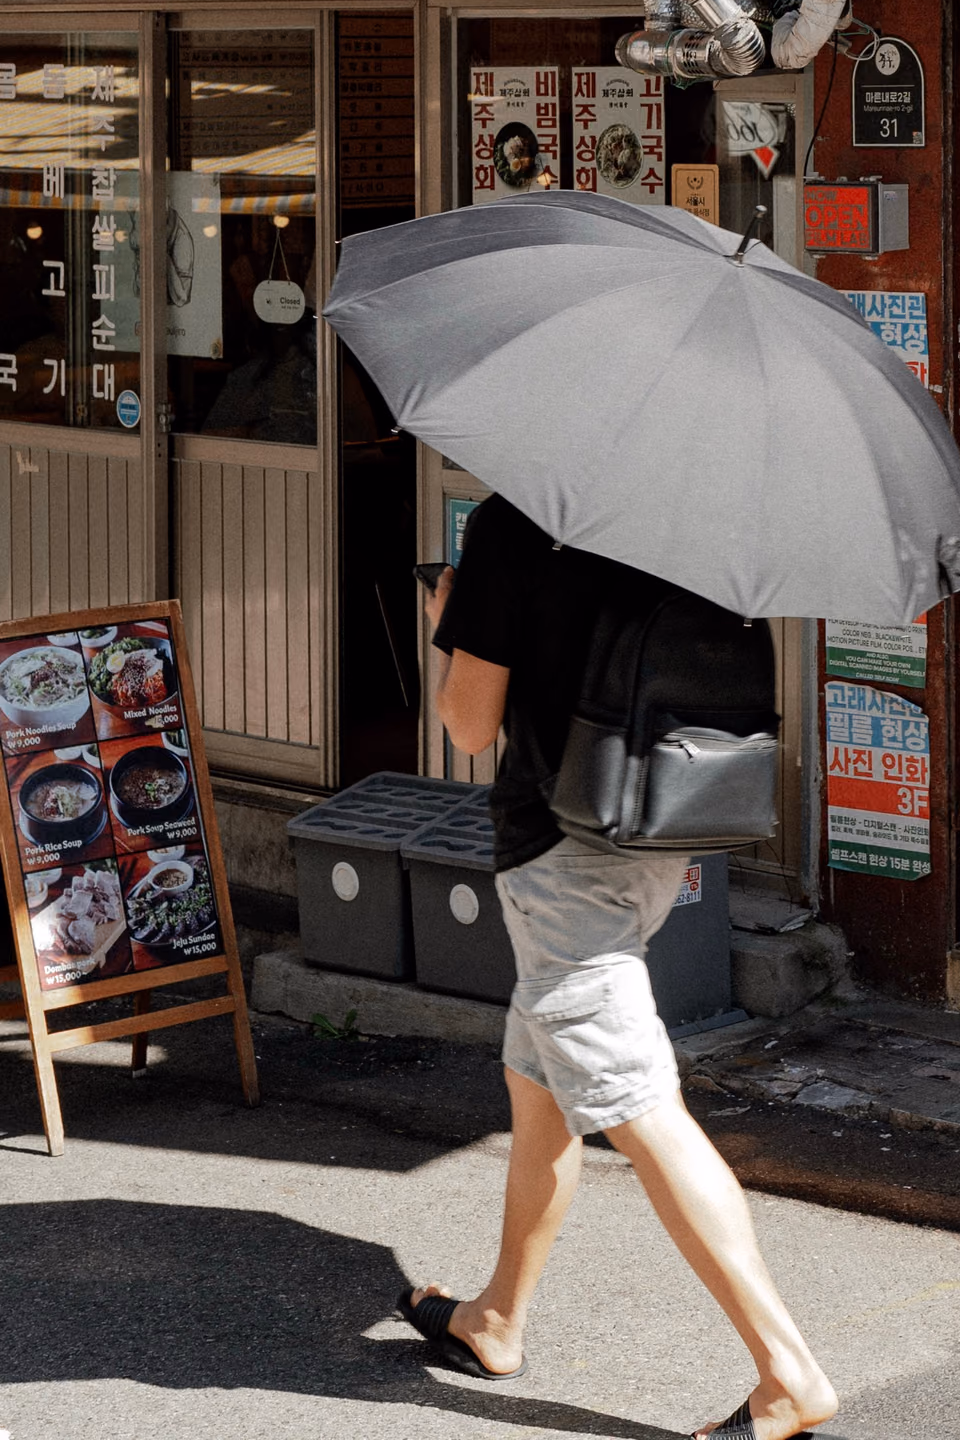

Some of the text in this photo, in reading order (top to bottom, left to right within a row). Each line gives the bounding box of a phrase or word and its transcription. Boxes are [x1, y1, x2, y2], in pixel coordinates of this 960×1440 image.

[865, 91, 911, 104] 마른내로2길
[473, 71, 496, 191] 제주상회
[535, 70, 559, 189] 비빔국수
[574, 71, 598, 193] 제주상회
[880, 118, 898, 138] 31
[806, 190, 838, 202] NOW
[805, 206, 868, 228] OPEN
[42, 63, 66, 397] 돔베고기
[806, 231, 868, 247] FILM LAB
[280, 296, 300, 305] Closed
[828, 684, 926, 718] 고래사진
[124, 705, 177, 719] Mixed Noodles
[6, 723, 77, 740] Pork Noodles Soup
[829, 712, 928, 751] 필름 현상
[829, 745, 928, 785] 사진 인화
[897, 787, 929, 815] 3F
[127, 817, 196, 837] Pork Soup Seaweed
[25, 838, 83, 856] Pork Rice Soup
[830, 848, 931, 874] 셀프스캔 현상 15분 완성
[173, 932, 216, 949] Jeju Sundae
